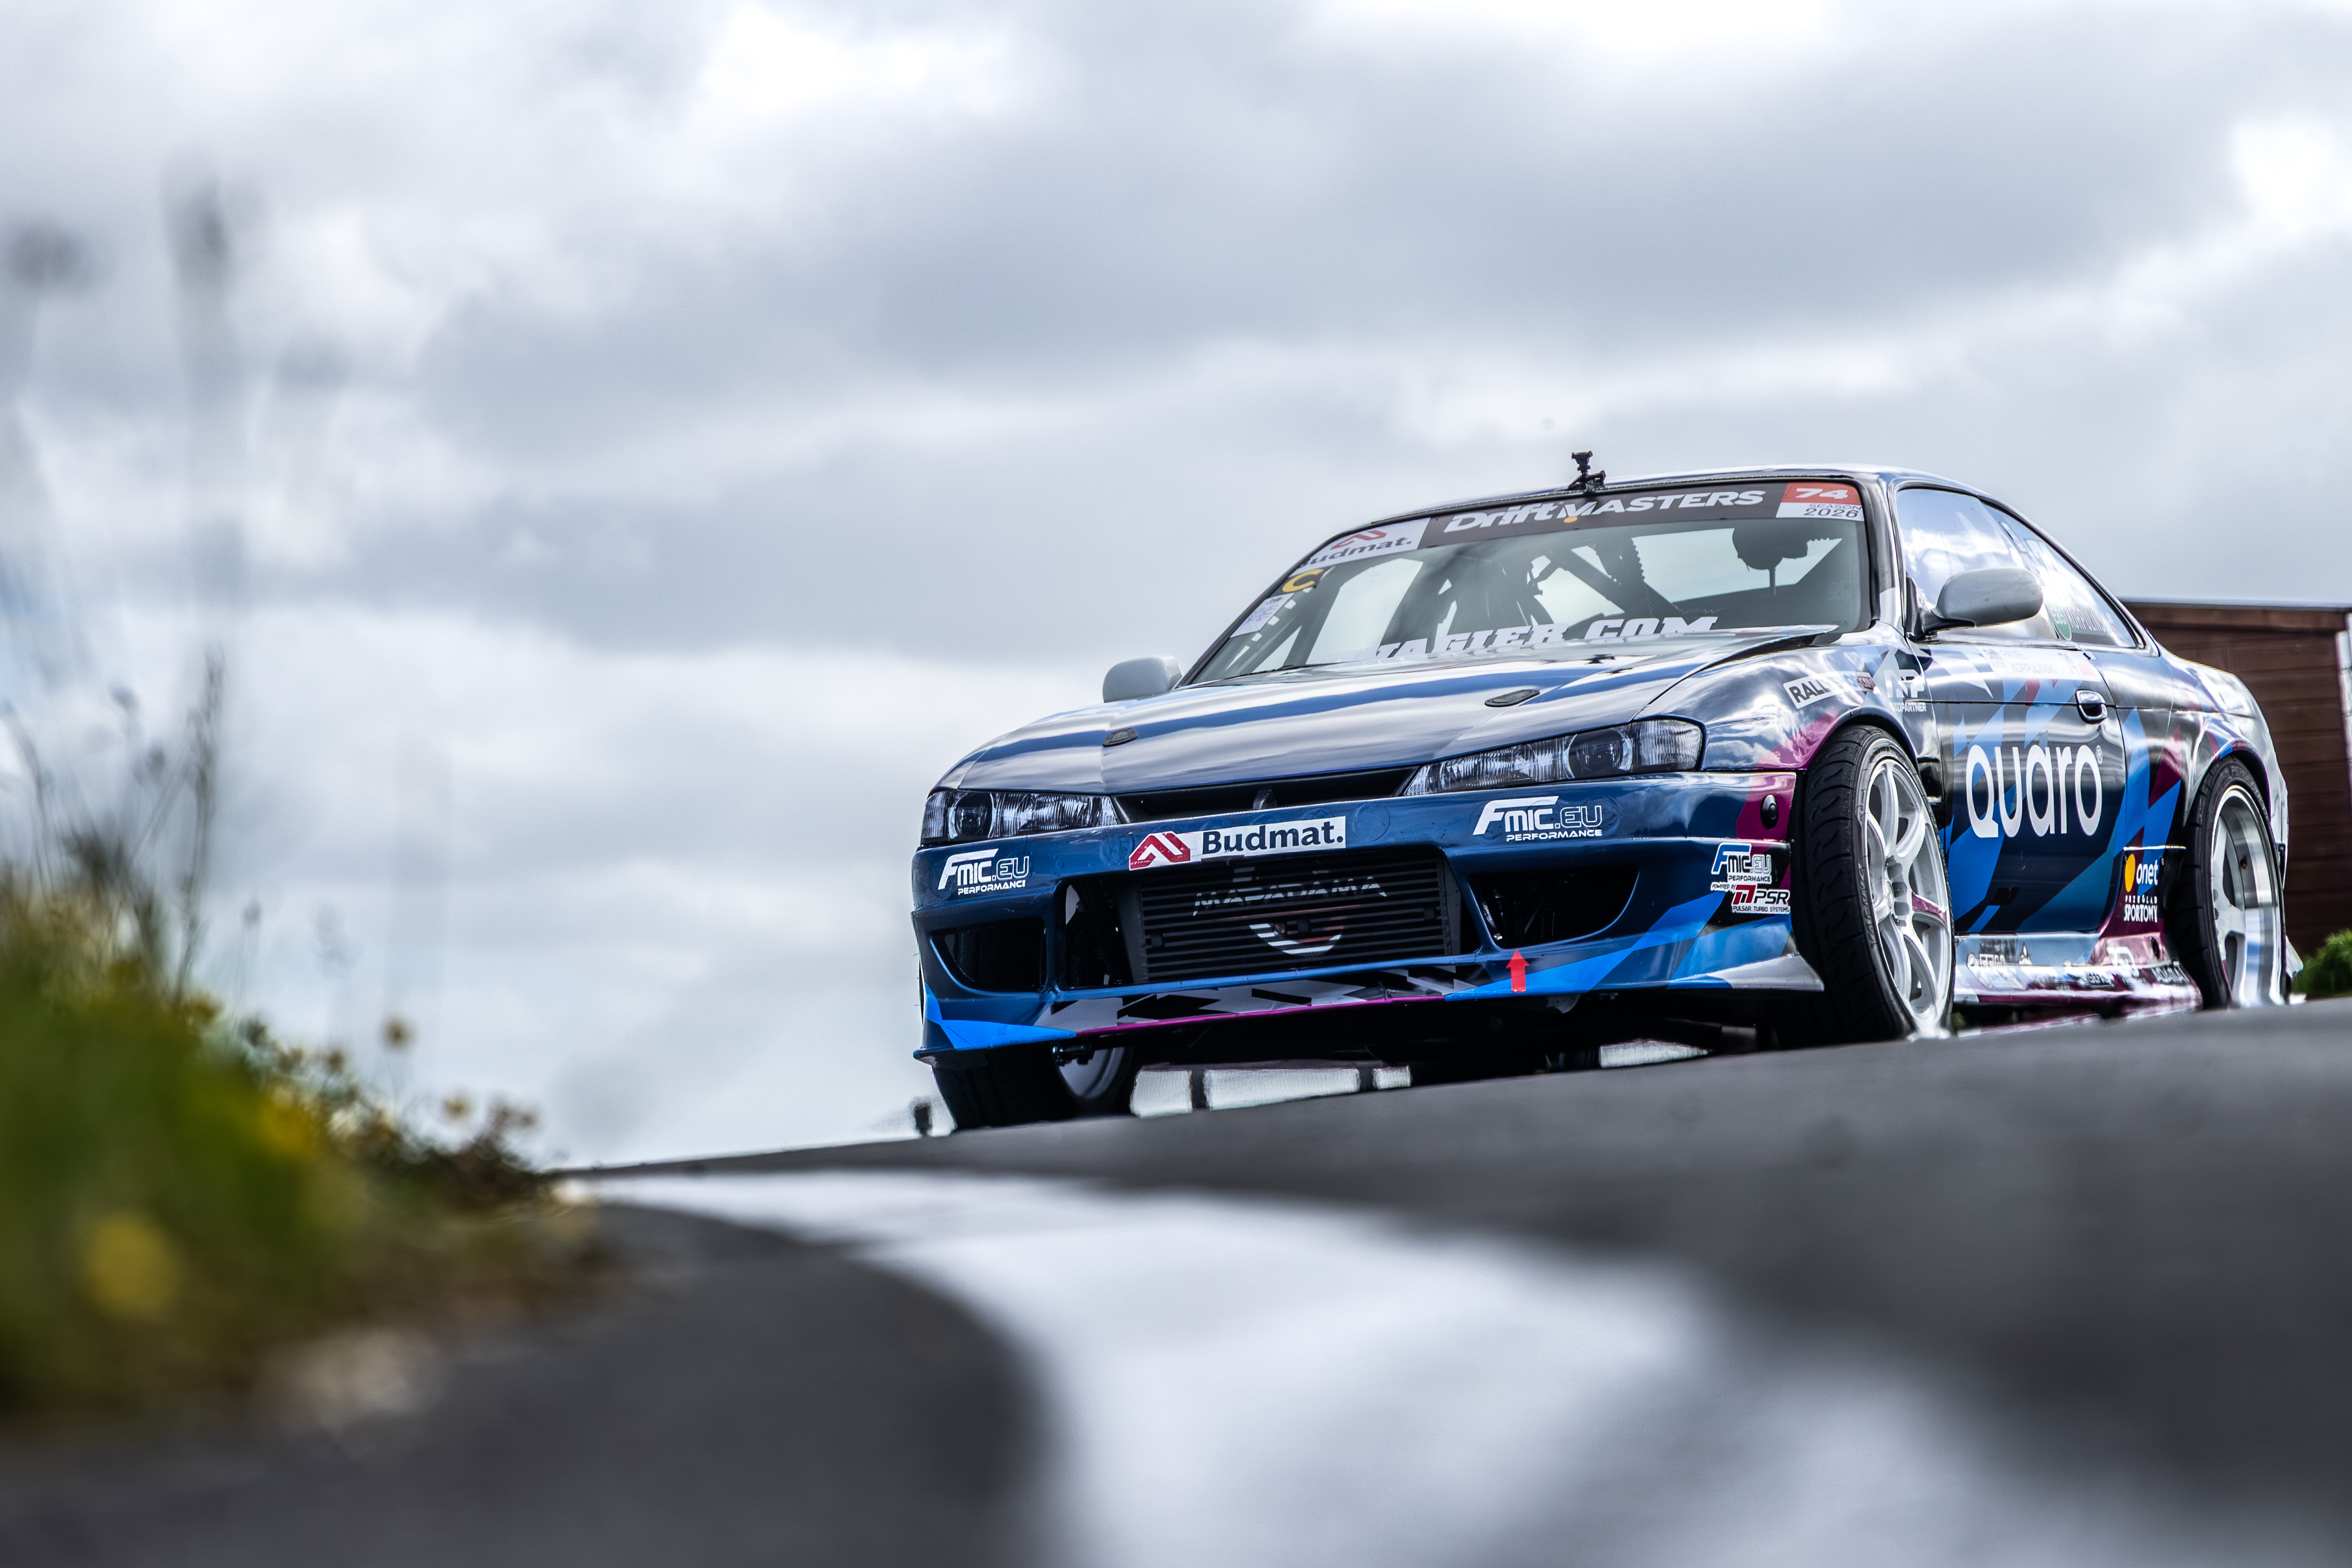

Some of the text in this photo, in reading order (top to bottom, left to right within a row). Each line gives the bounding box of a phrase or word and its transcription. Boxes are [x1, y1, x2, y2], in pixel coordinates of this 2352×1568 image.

[1795, 488, 1849, 500] 74
[1803, 508, 1860, 518] 2026
[1300, 536, 1412, 567] udmat.
[1202, 821, 1344, 855] Budmat.
[1506, 829, 1603, 842] PERFORMANCE
[2136, 859, 2159, 886] onet
[957, 880, 1026, 895] PERFORMANCE
[1753, 890, 1789, 905] PSR
[2123, 904, 2158, 923] SPORTOWY
